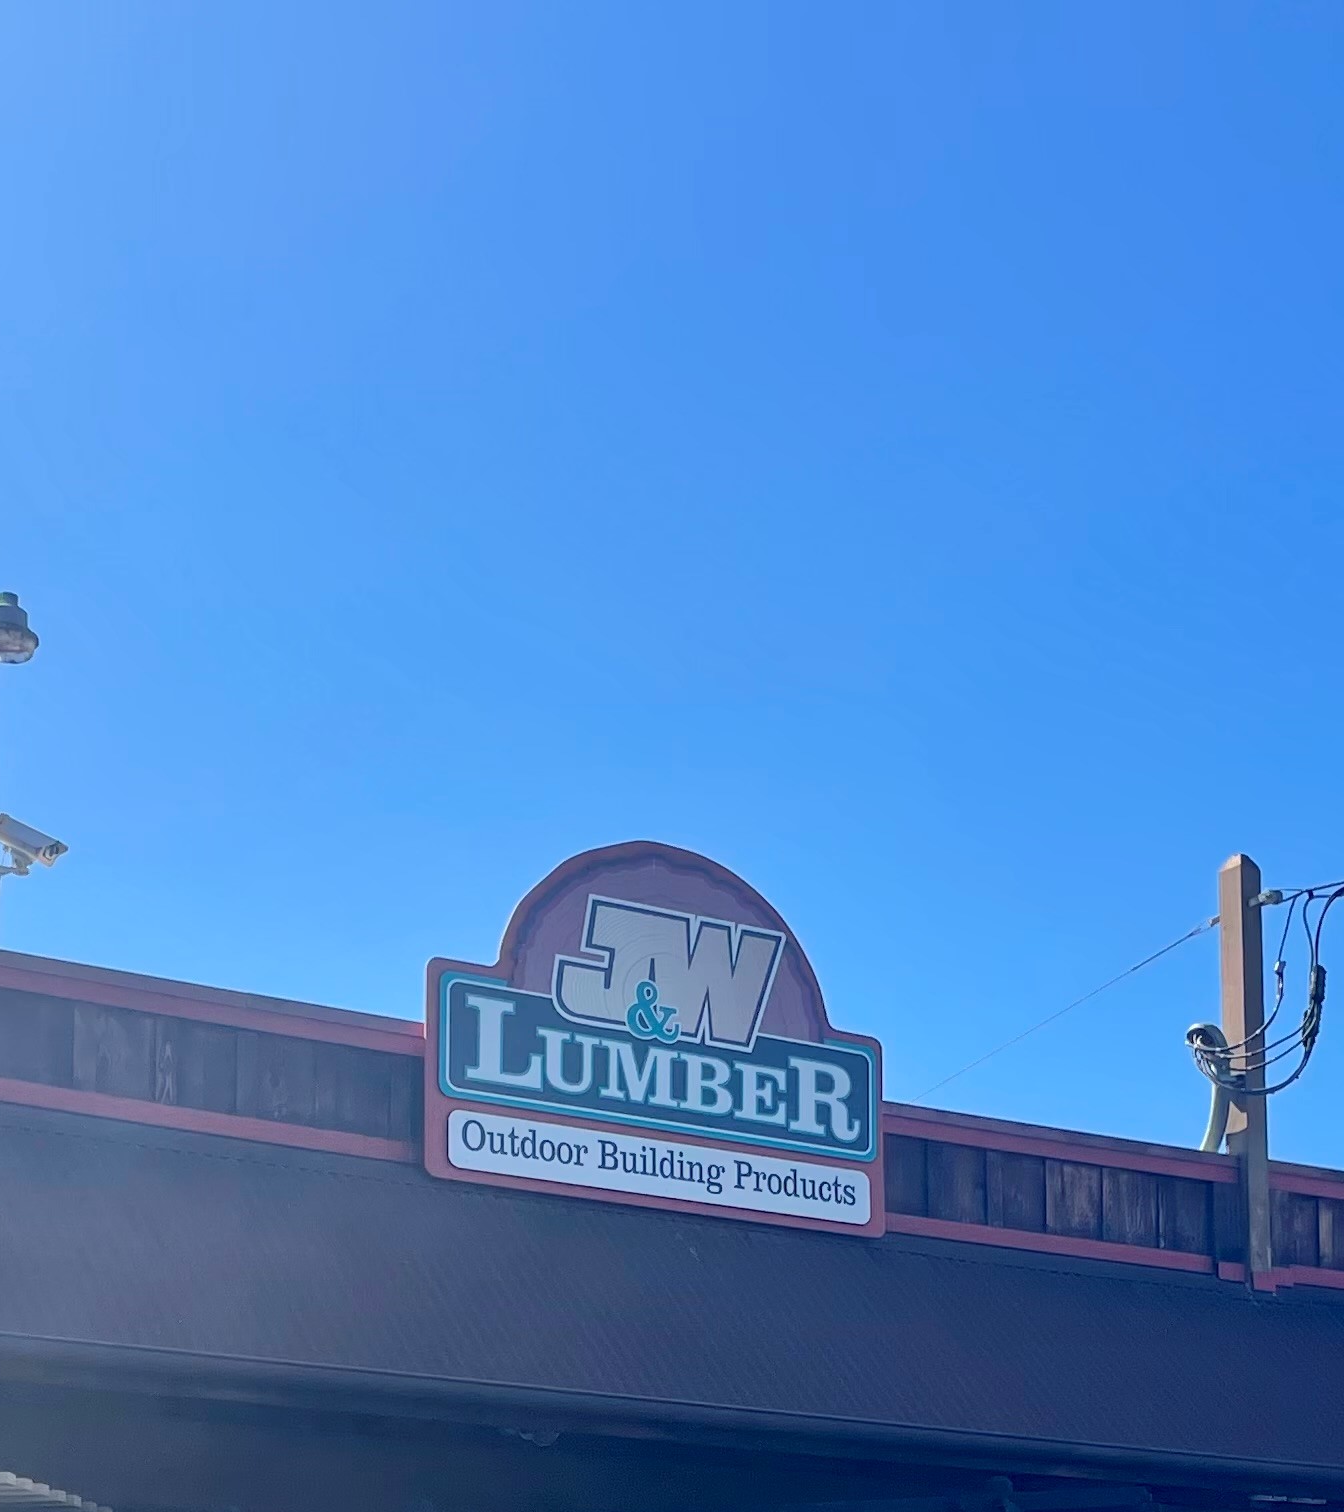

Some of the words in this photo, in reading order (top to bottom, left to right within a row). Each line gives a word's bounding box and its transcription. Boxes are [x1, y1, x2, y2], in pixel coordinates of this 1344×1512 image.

[464, 994, 861, 1143] LUMBER
[461, 1120, 588, 1167] Outdoor
[597, 1139, 725, 1194] Building
[733, 1160, 857, 1206] Products
